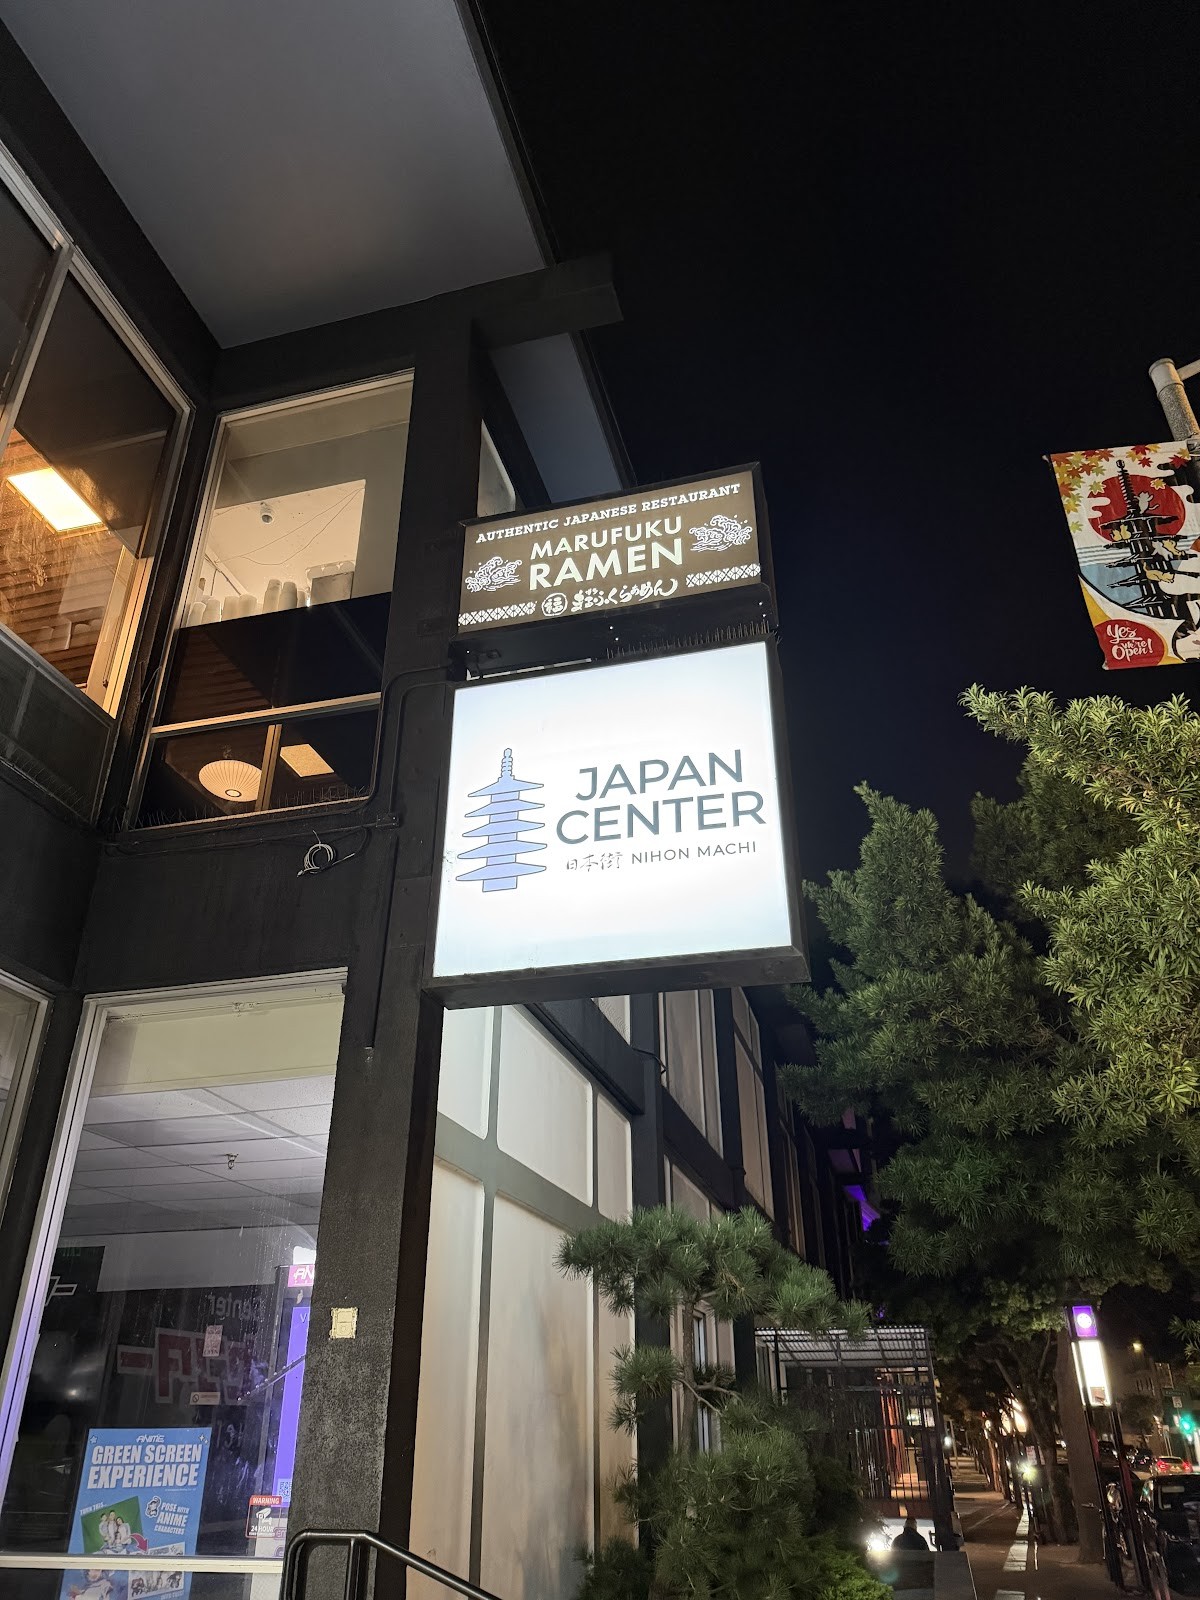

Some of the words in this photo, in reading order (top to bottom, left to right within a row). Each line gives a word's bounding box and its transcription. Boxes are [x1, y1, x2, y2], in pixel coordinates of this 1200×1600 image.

[475, 518, 559, 544] AUTHENTIC
[563, 504, 637, 527] JAPANESE
[641, 484, 741, 512] RESTAURANT
[530, 516, 682, 560] MARUFUKU
[529, 538, 683, 591] RAMEN
[1106, 624, 1143, 644] Yes
[575, 749, 743, 801] JAPAN
[556, 790, 767, 845] CENTER
[631, 847, 690, 865] NIHON
[697, 841, 757, 858] MACHI
[91, 1445, 142, 1465] GREEN
[144, 1443, 203, 1464] SCREEN
[87, 1463, 200, 1489] EXPERIENCE
[157, 1512, 189, 1527] ANIME
[161, 1502, 178, 1512] POSE
[154, 1525, 185, 1535] CHARACTERS
